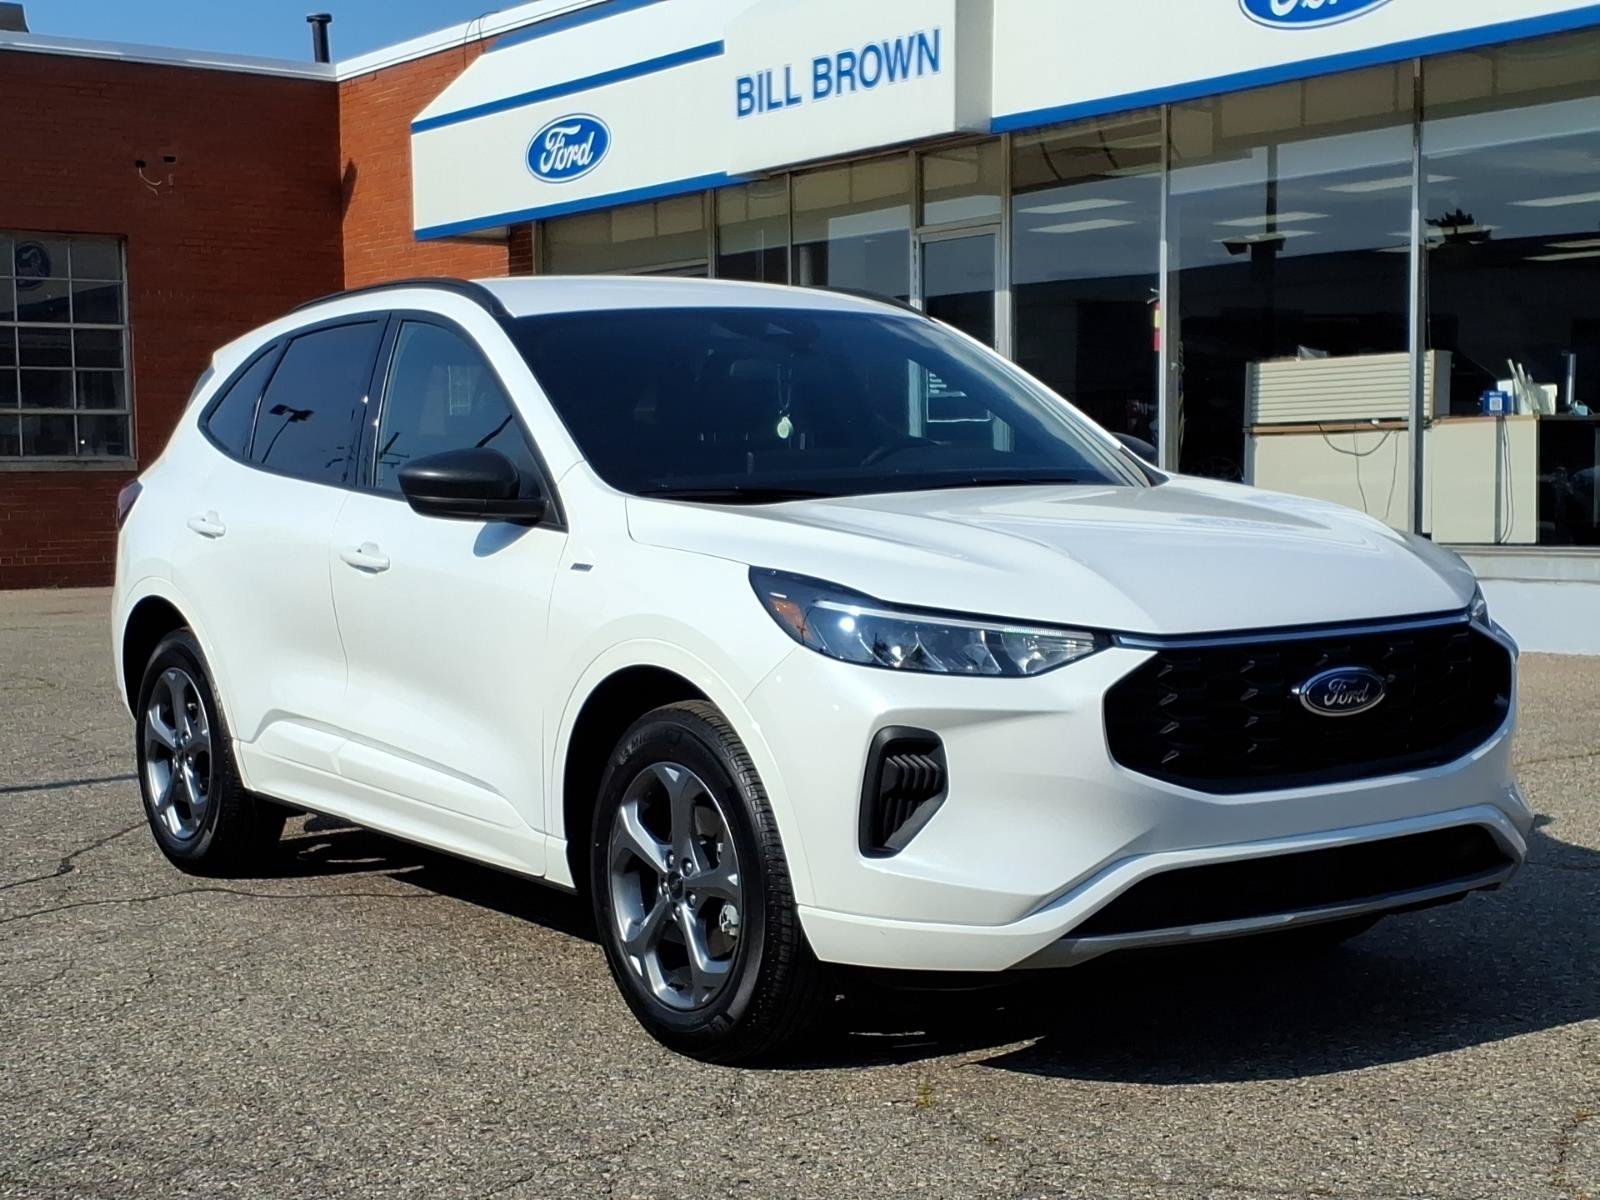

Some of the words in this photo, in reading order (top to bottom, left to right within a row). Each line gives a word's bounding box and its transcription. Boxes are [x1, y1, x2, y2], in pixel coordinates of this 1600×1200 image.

[736, 65, 802, 118] BILL
[812, 28, 940, 100] BROWN
[540, 123, 596, 174] Ford
[1323, 678, 1370, 706] Ford
